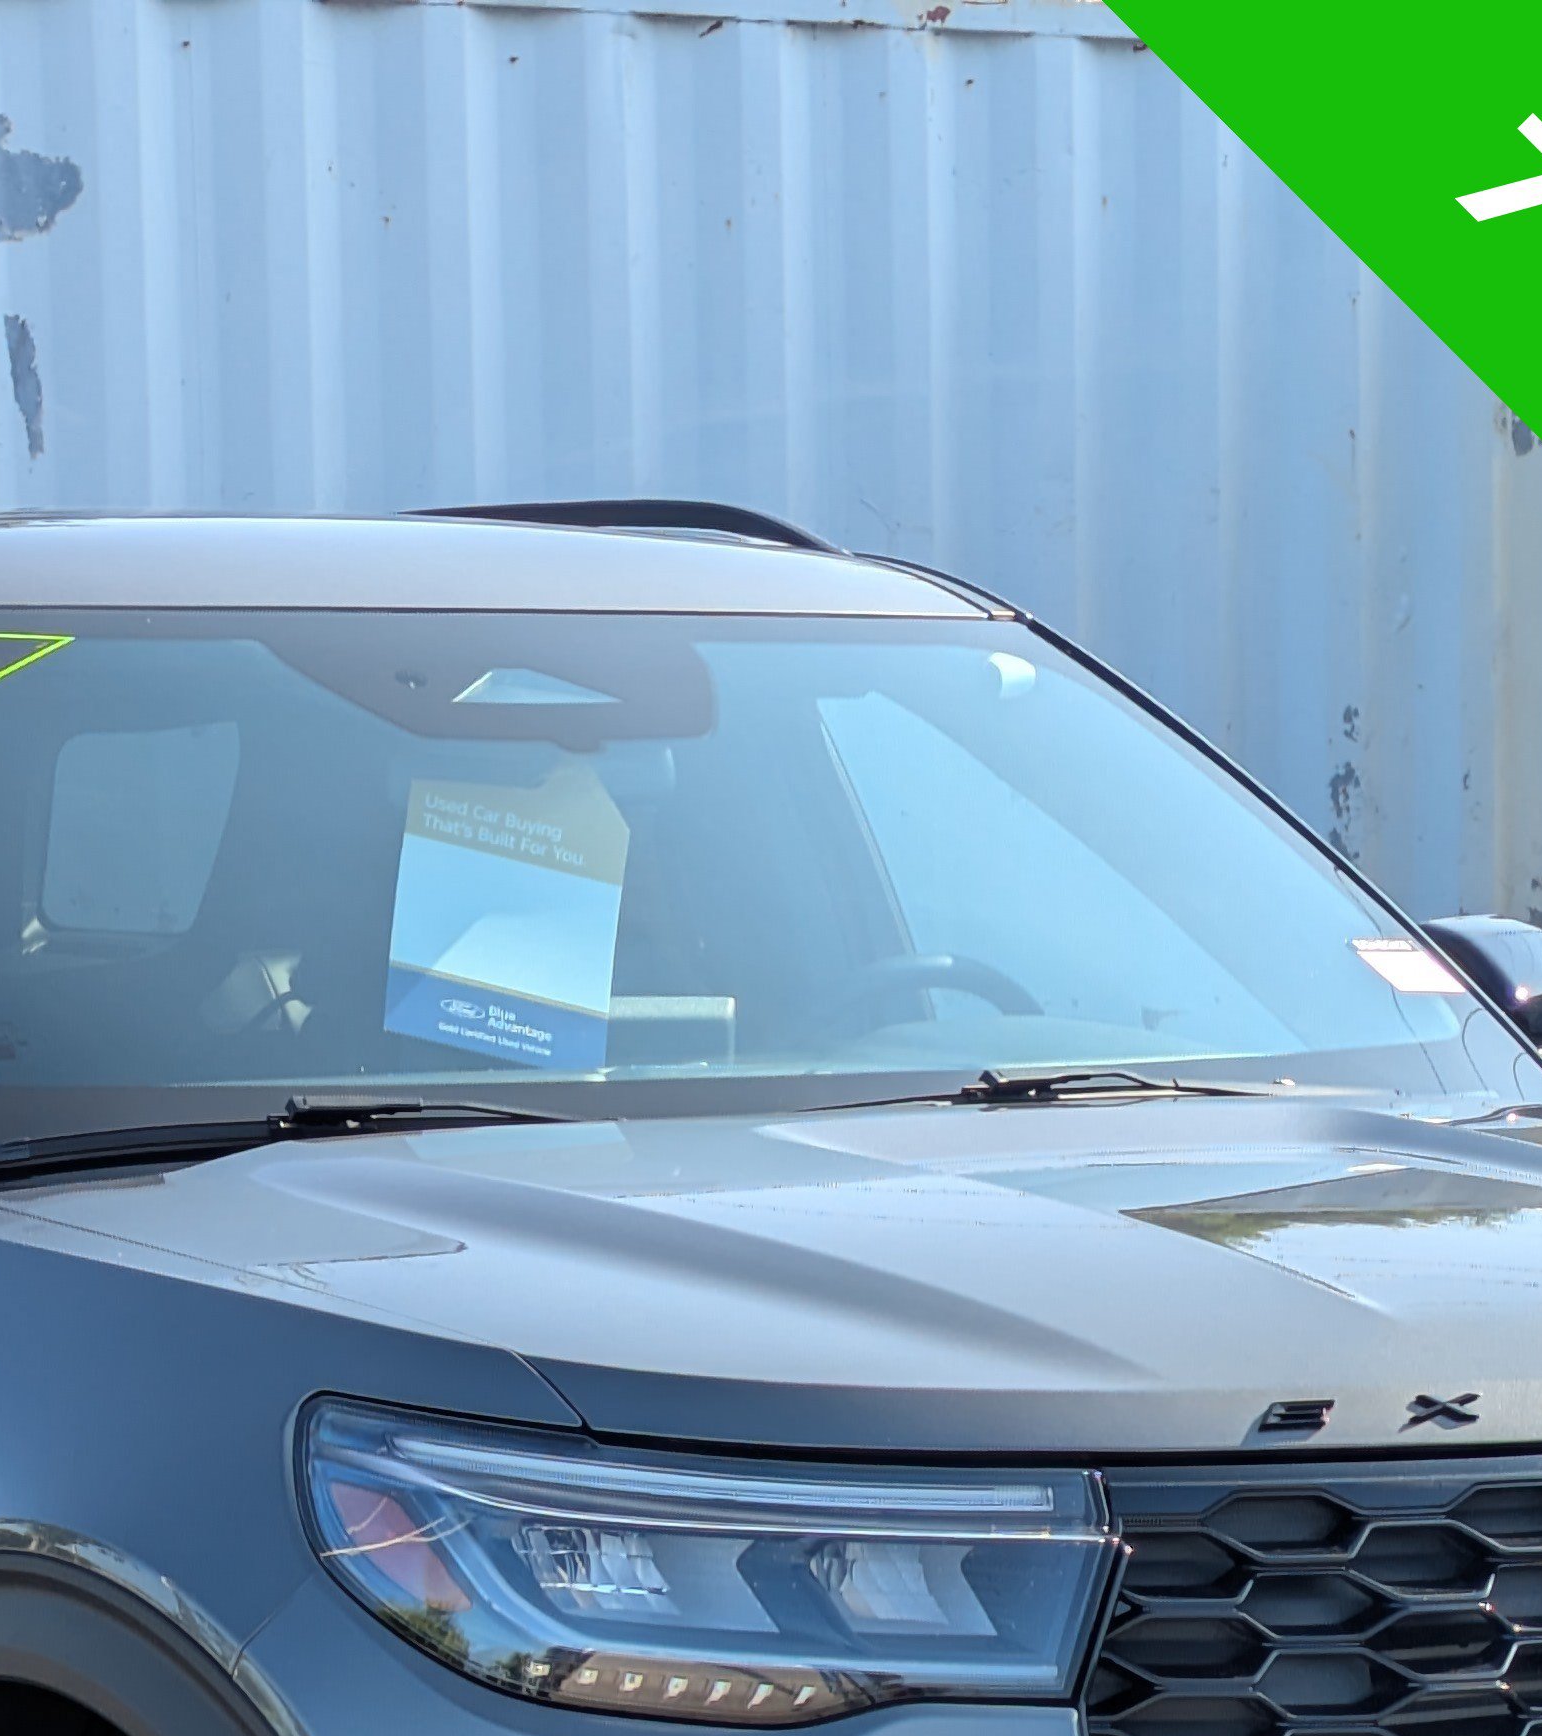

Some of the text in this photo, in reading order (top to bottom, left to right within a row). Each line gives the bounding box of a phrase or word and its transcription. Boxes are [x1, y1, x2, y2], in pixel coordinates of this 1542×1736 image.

[423, 812, 473, 839] That's
[477, 825, 515, 850] Built
[519, 836, 548, 858] For
[424, 791, 563, 843] Used Car Buying
[487, 1017, 553, 1042] Advantage
